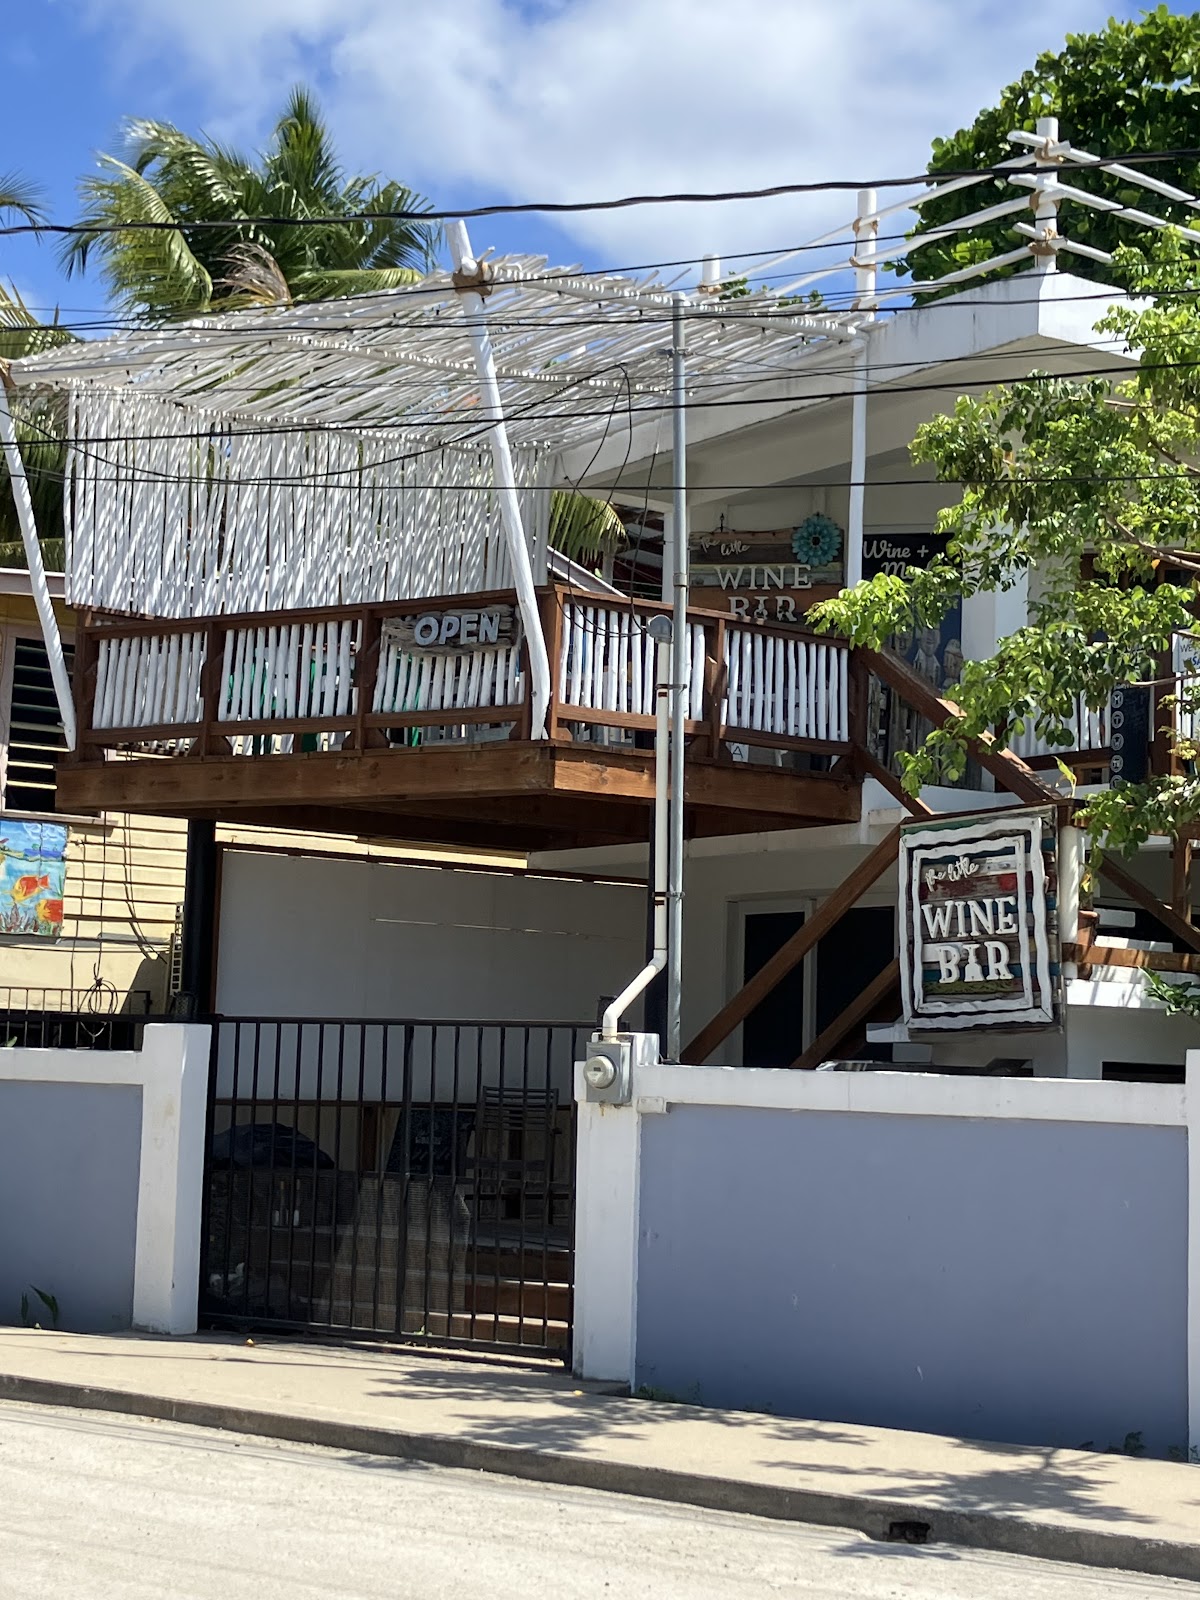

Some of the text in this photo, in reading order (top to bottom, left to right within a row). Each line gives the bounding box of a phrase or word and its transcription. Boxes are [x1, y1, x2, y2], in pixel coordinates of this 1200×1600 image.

[863, 540, 911, 559] Wine
[714, 564, 812, 591] WINE
[414, 612, 500, 646] OPEN
[921, 896, 1018, 939] WINE
